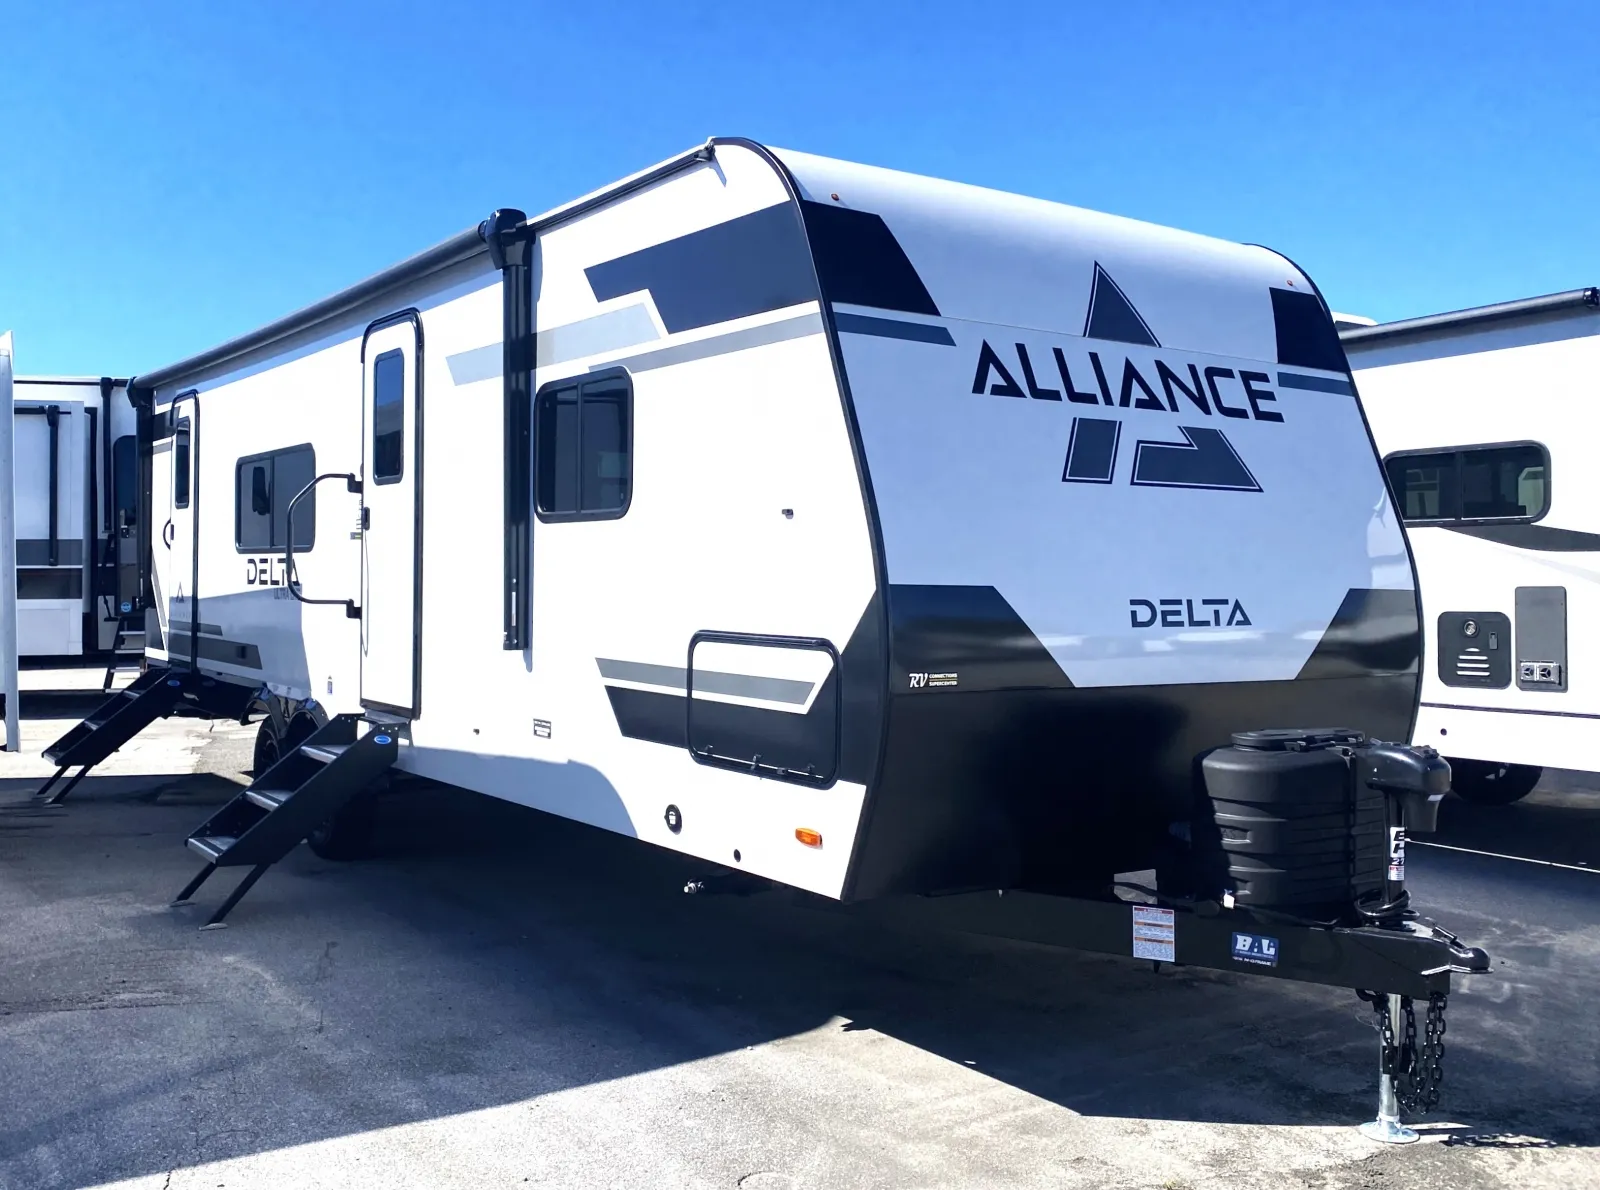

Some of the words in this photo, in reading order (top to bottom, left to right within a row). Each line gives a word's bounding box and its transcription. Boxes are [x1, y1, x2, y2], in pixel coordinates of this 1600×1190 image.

[971, 339, 1285, 423] ALLIANCE
[247, 558, 300, 586] DELTA
[1129, 598, 1253, 628] DELTA
[909, 673, 928, 688] RV
